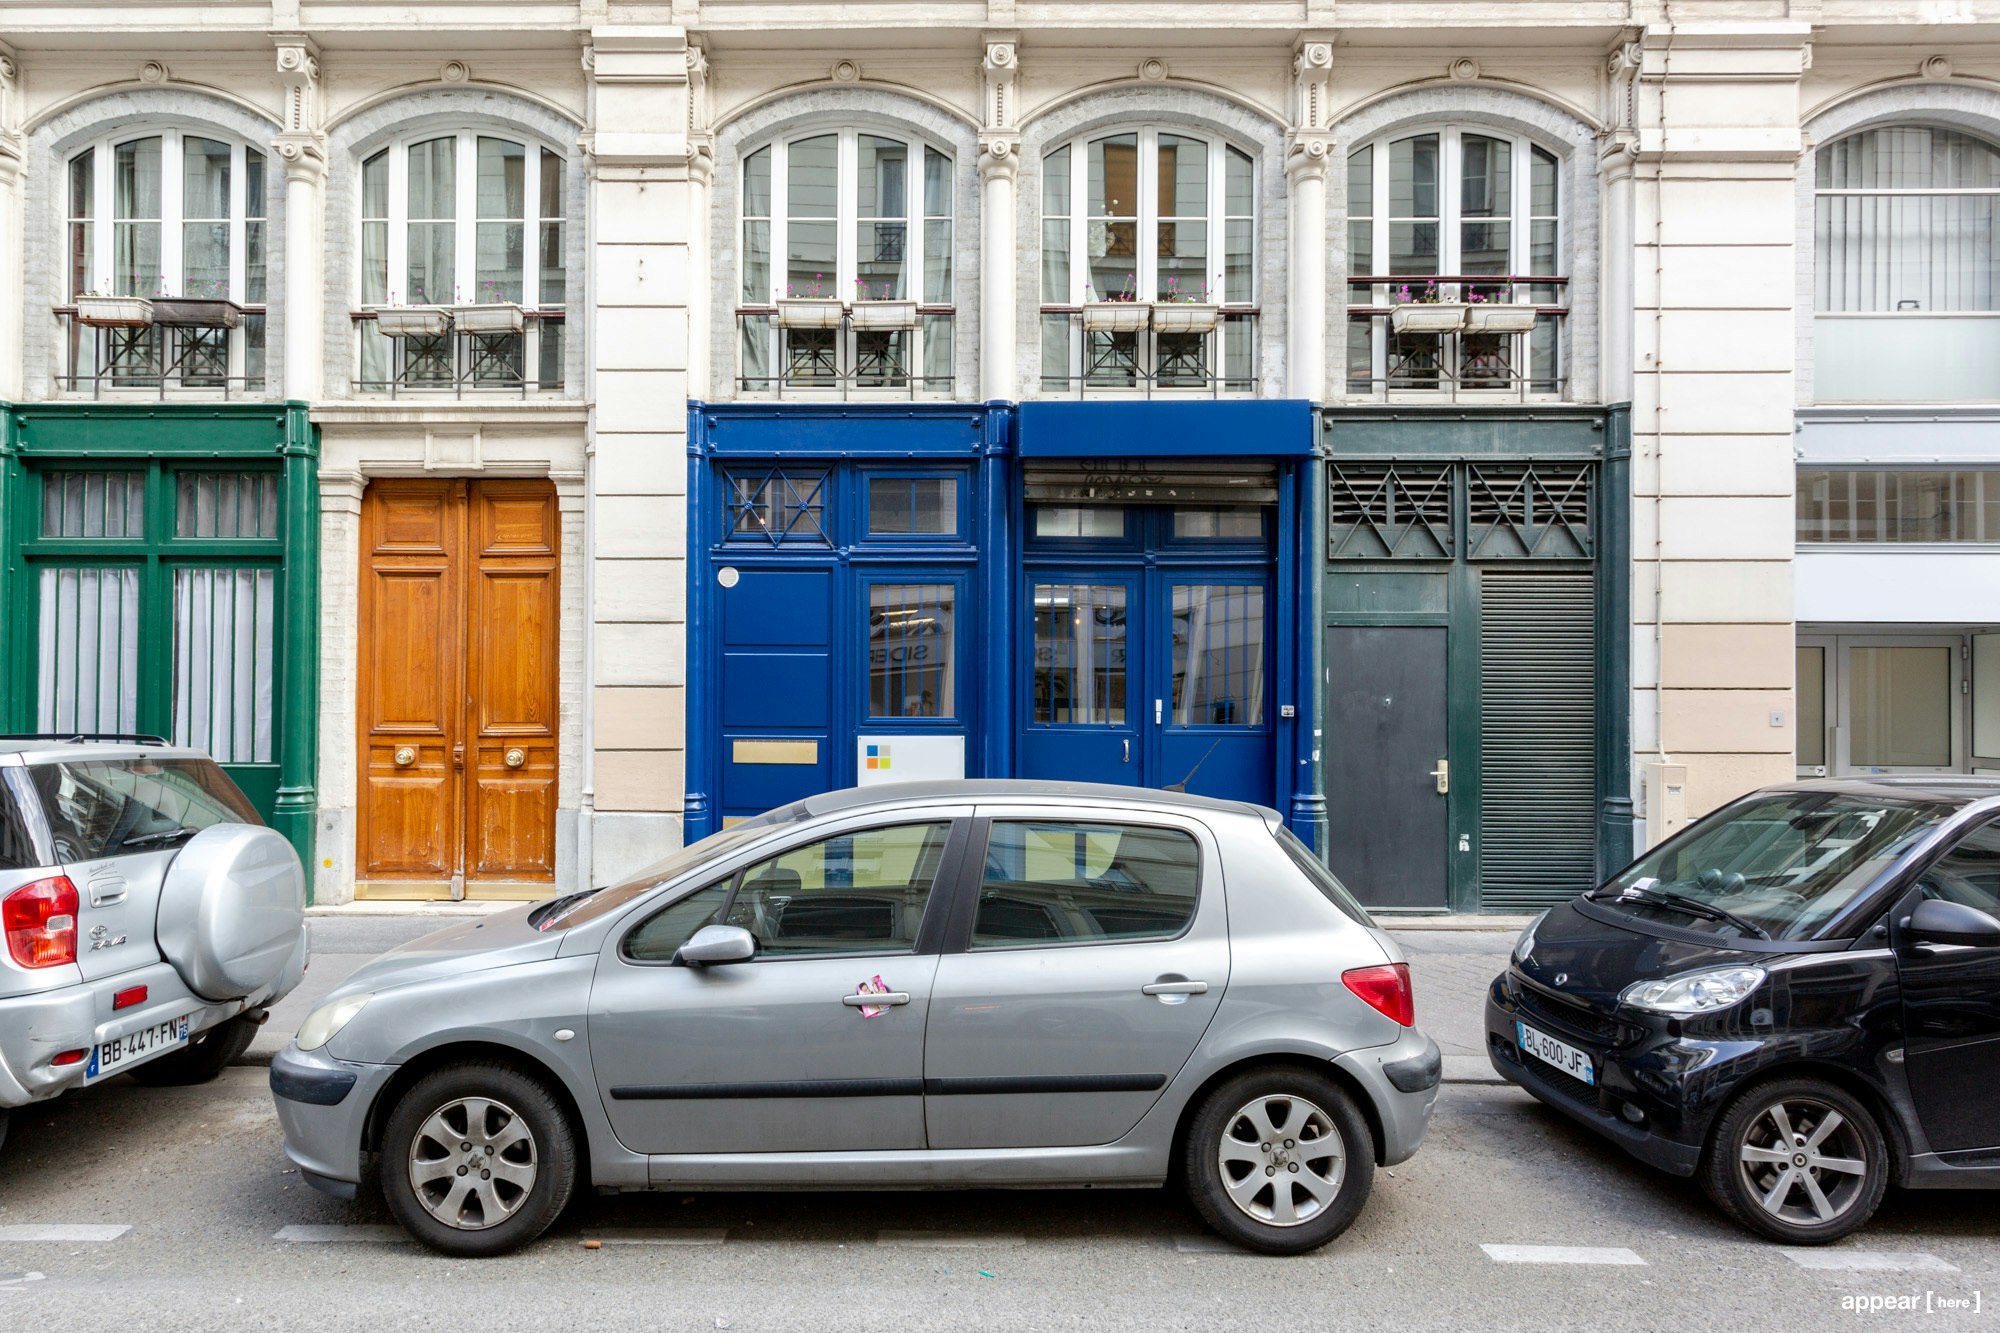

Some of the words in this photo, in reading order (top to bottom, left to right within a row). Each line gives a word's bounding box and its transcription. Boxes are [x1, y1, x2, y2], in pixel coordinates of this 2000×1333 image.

[102, 1018, 178, 1066] BB-447-FN
[180, 1024, 188, 1039] 75
[1525, 1028, 1583, 1073] BL-600-JF
